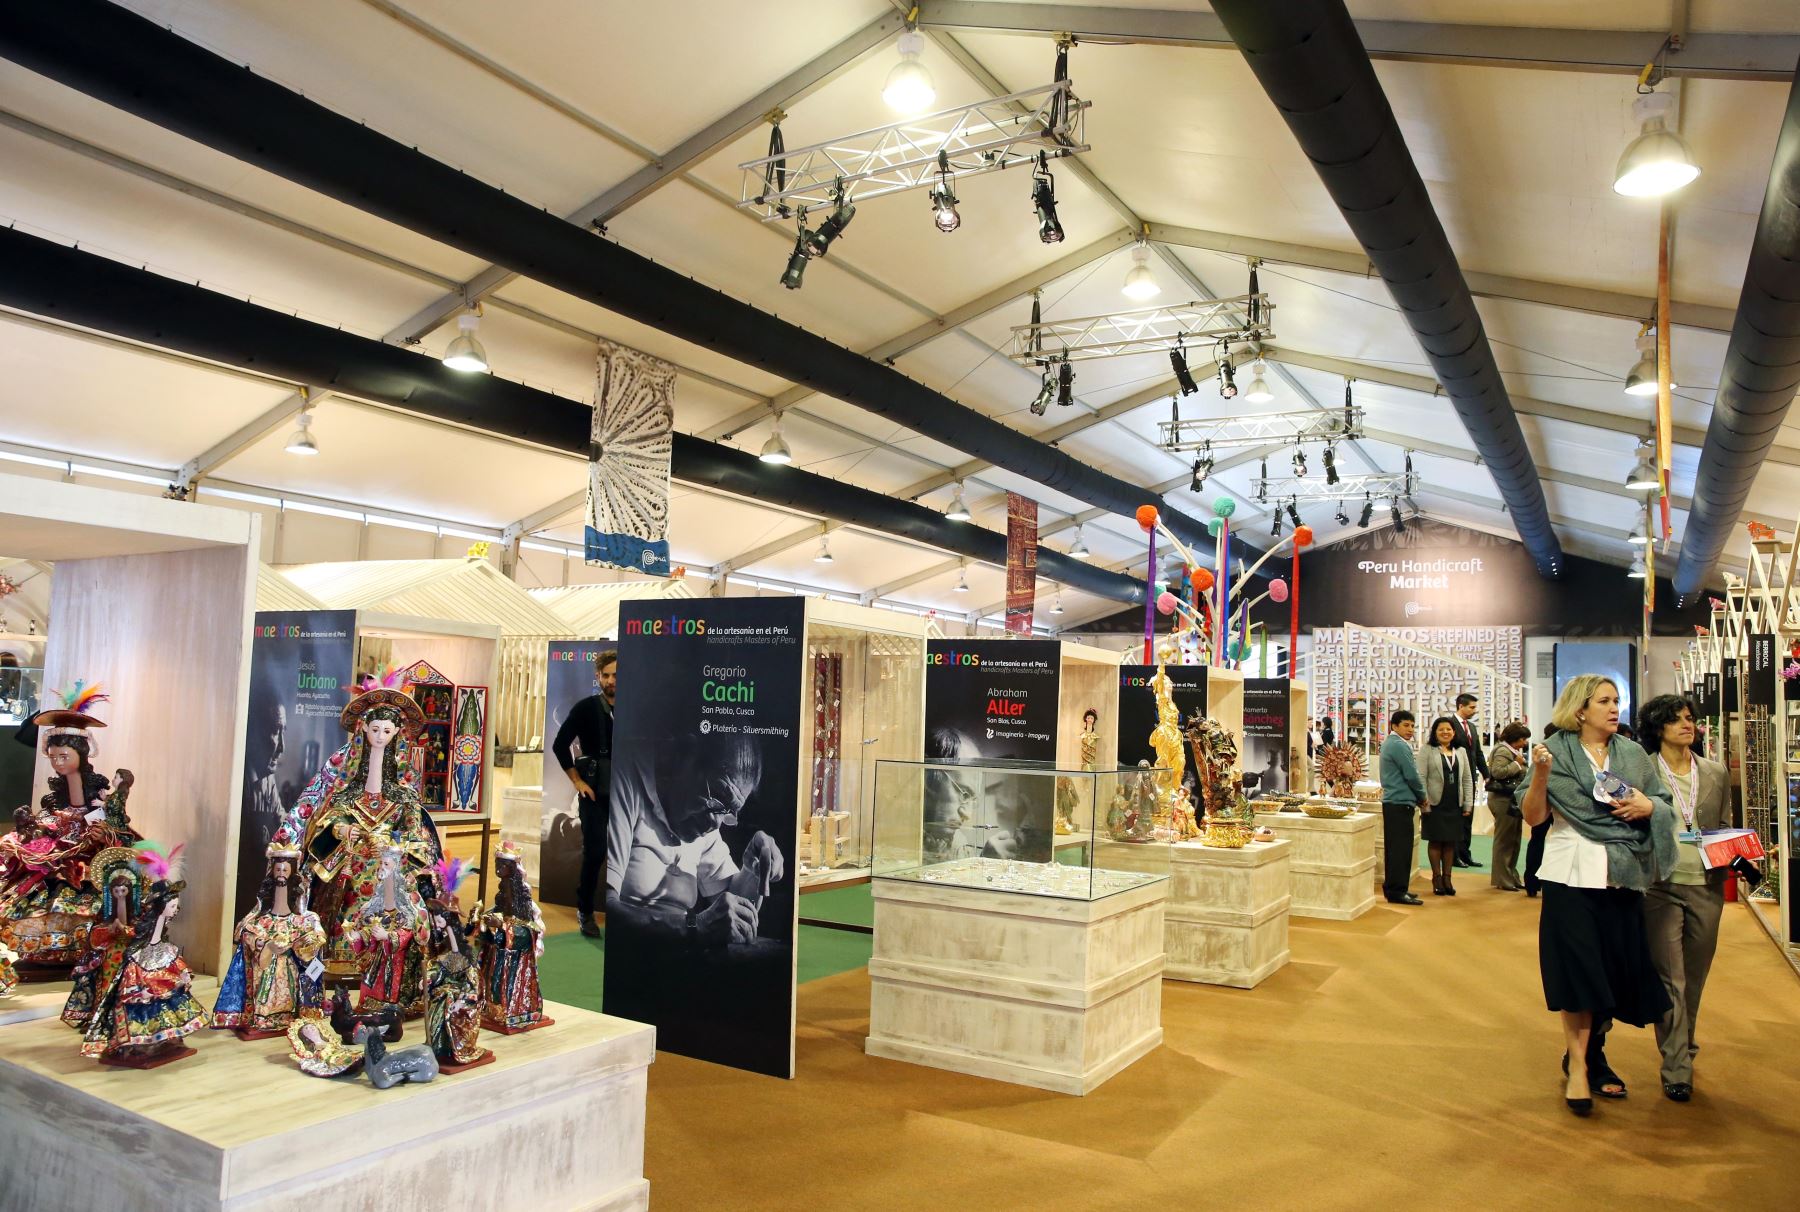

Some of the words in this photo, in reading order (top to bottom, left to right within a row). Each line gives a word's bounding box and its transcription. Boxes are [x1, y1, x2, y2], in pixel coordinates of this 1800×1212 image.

[1358, 560, 1398, 574] Peru
[1402, 558, 1484, 574] Handicraft
[1390, 574, 1450, 589] Market
[255, 624, 300, 638] maestros
[626, 614, 705, 635] maestros
[724, 626, 754, 635] artesanía
[773, 626, 789, 635] Perú
[707, 636, 743, 646] handicrafts
[772, 636, 780, 645] of
[1438, 629, 1495, 643] REFINED
[552, 649, 598, 662] maestros
[1314, 644, 1456, 657] PERFECTIOST
[927, 650, 980, 666] aestros
[703, 664, 746, 680] Gregorio
[1348, 668, 1462, 680] TRADICIONAL
[298, 673, 337, 690] Urbano
[1120, 675, 1145, 686] tros
[703, 681, 755, 702] Cachi
[987, 687, 1028, 698] Abraham
[1347, 681, 1464, 694] HANDICRAFT
[702, 706, 714, 715] San
[715, 706, 735, 716] Pablo,
[736, 708, 755, 716] Cusco
[986, 699, 1025, 715] Aller
[742, 725, 789, 737] Silversmithing
[1028, 732, 1050, 741] Imagery
